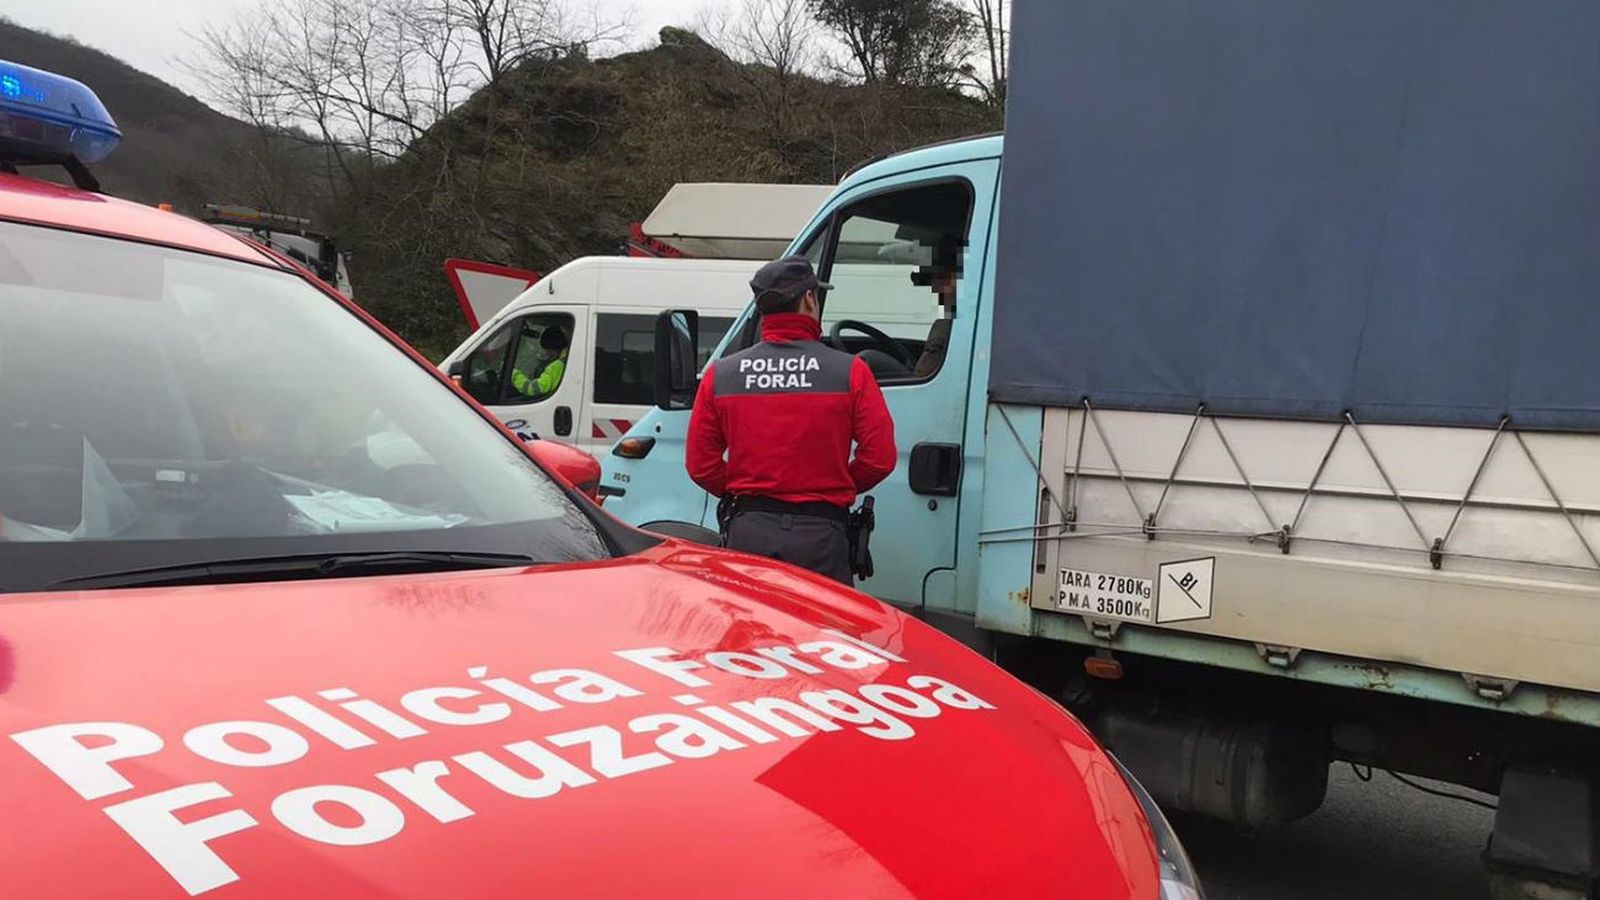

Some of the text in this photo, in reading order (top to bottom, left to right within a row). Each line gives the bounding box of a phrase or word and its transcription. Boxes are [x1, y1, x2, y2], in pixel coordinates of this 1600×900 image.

[740, 354, 820, 372] POLICÍA
[745, 373, 812, 389] FORAL
[1061, 570, 1151, 599] TARA 2780Kg
[9, 629, 908, 800] Policía Foral
[101, 675, 997, 896] Foruzaingoa
